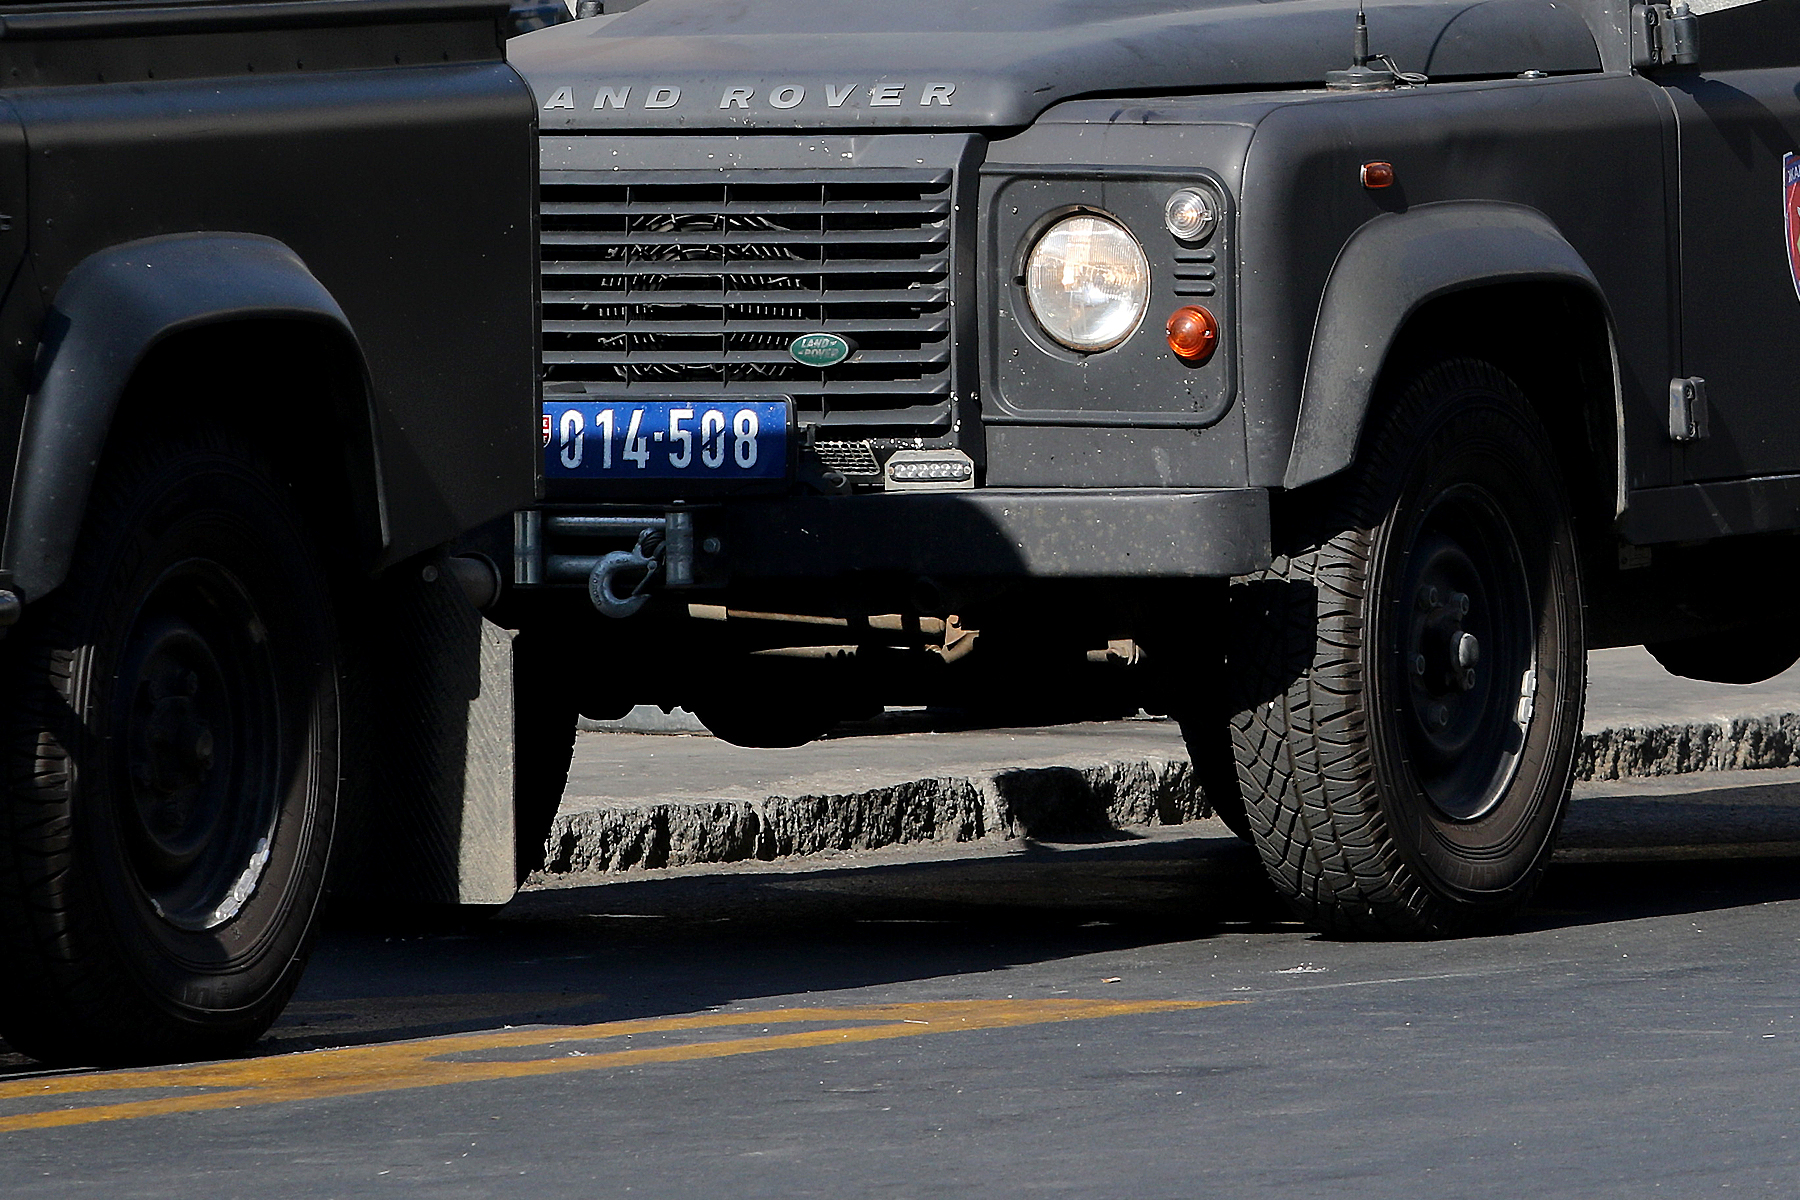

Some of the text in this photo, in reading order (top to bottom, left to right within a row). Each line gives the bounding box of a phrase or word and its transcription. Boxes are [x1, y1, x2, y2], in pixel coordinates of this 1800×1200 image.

[719, 82, 957, 110] ROVER
[801, 338, 830, 349] LAND
[804, 347, 840, 359] ROVER
